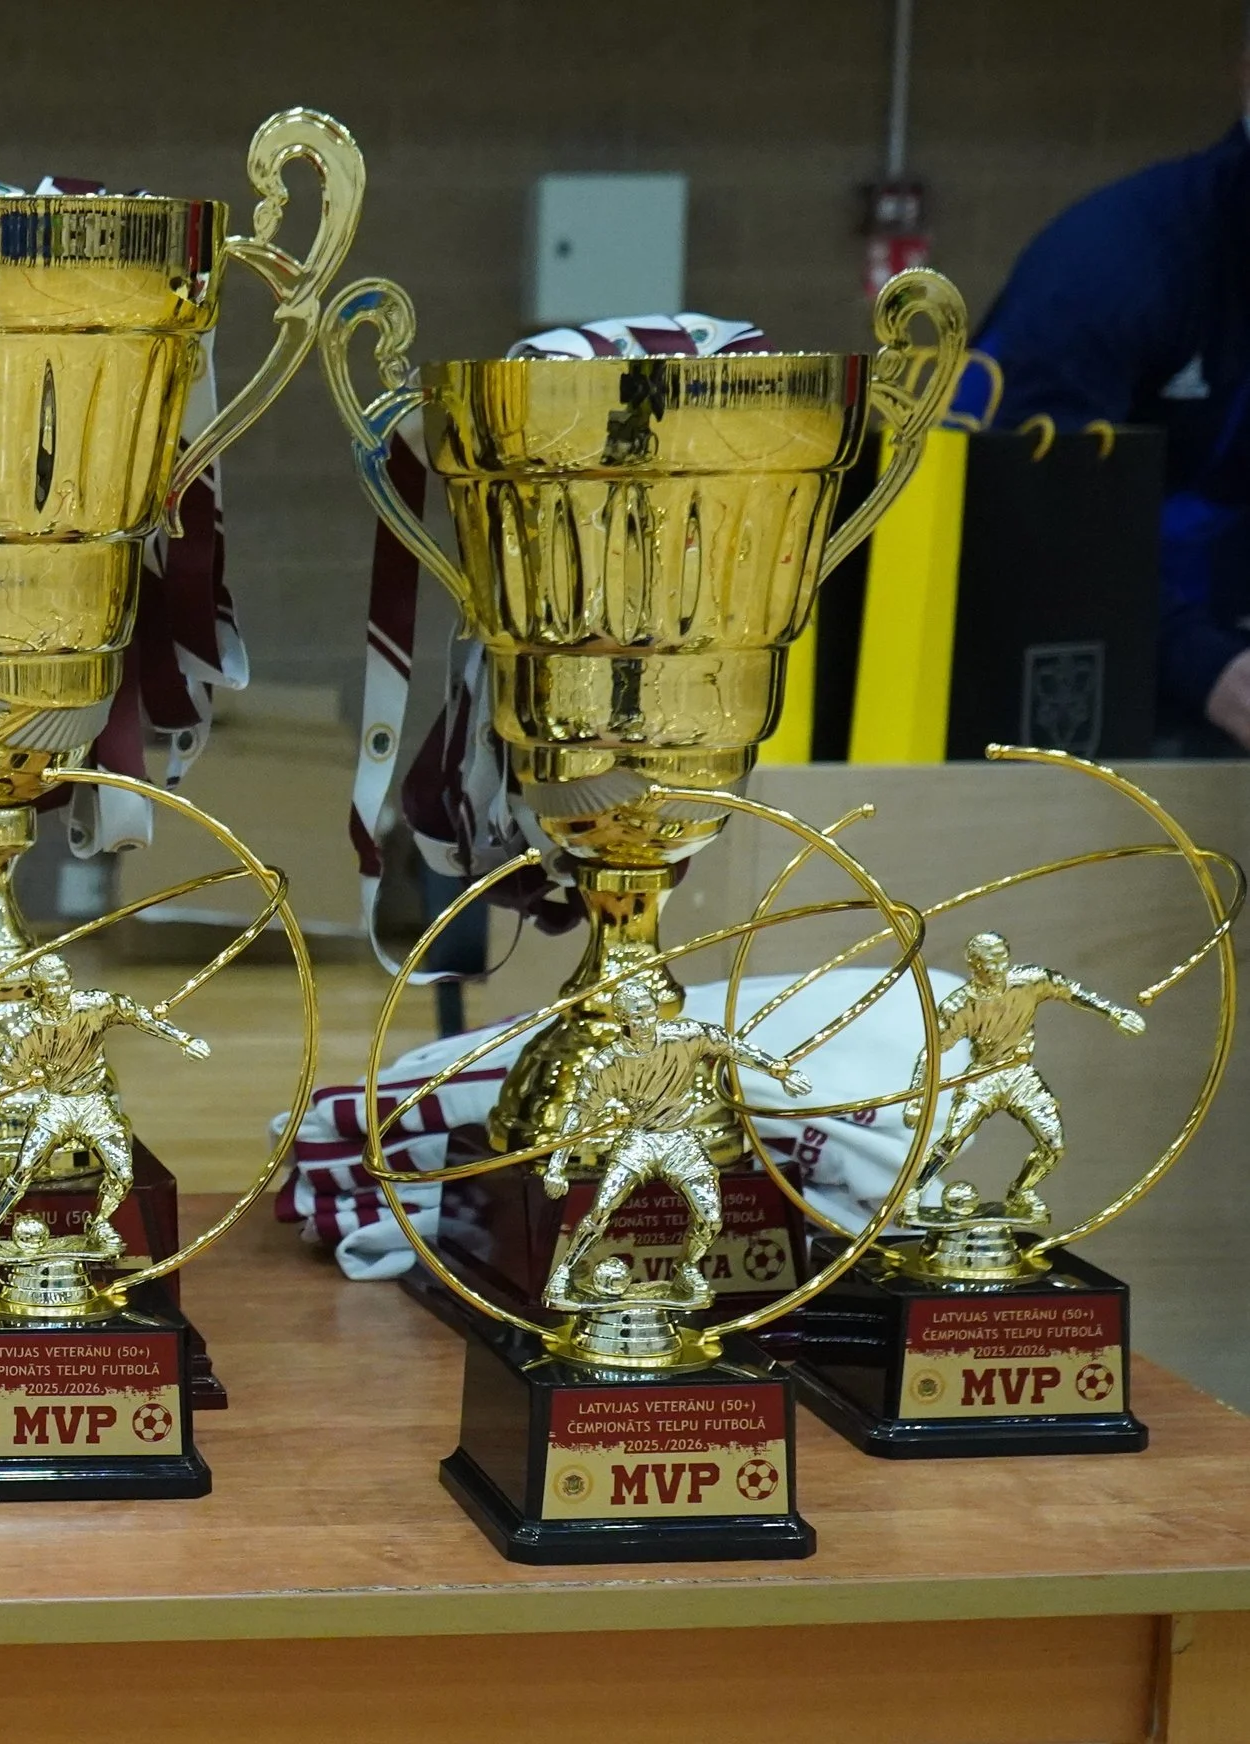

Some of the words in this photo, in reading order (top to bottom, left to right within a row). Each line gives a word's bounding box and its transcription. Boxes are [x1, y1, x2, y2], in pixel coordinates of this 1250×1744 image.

[724, 1209, 766, 1223] TBOLĀ
[933, 1311, 988, 1323] LATVIJAS
[993, 1308, 1057, 1322] VETERĀNU
[1062, 1309, 1095, 1322] (50+)
[922, 1328, 998, 1341] ČEMPIONĀTS
[1004, 1327, 1042, 1339] TELPU
[1047, 1324, 1103, 1338] FUTBOLĀ
[45, 1345, 111, 1358] VETERĀNU
[117, 1346, 150, 1360] (50+)
[976, 1345, 1049, 1357] 2025./2026.
[56, 1365, 96, 1376] TELPU
[102, 1362, 160, 1376] FUTBOLĀ
[28, 1383, 104, 1394] 2025./2026.
[961, 1366, 1061, 1406] MVP
[579, 1402, 639, 1414] LATVIJAS
[645, 1399, 715, 1413] VETERĀNU
[721, 1399, 756, 1413] (50+)
[13, 1406, 117, 1445] MVP
[567, 1420, 651, 1434] ČEMPIONĀTS
[657, 1420, 699, 1432] TELPU
[704, 1416, 766, 1431] FUTBOLĀ
[627, 1438, 707, 1452] 2025./2026.
[610, 1462, 720, 1505] MVP
